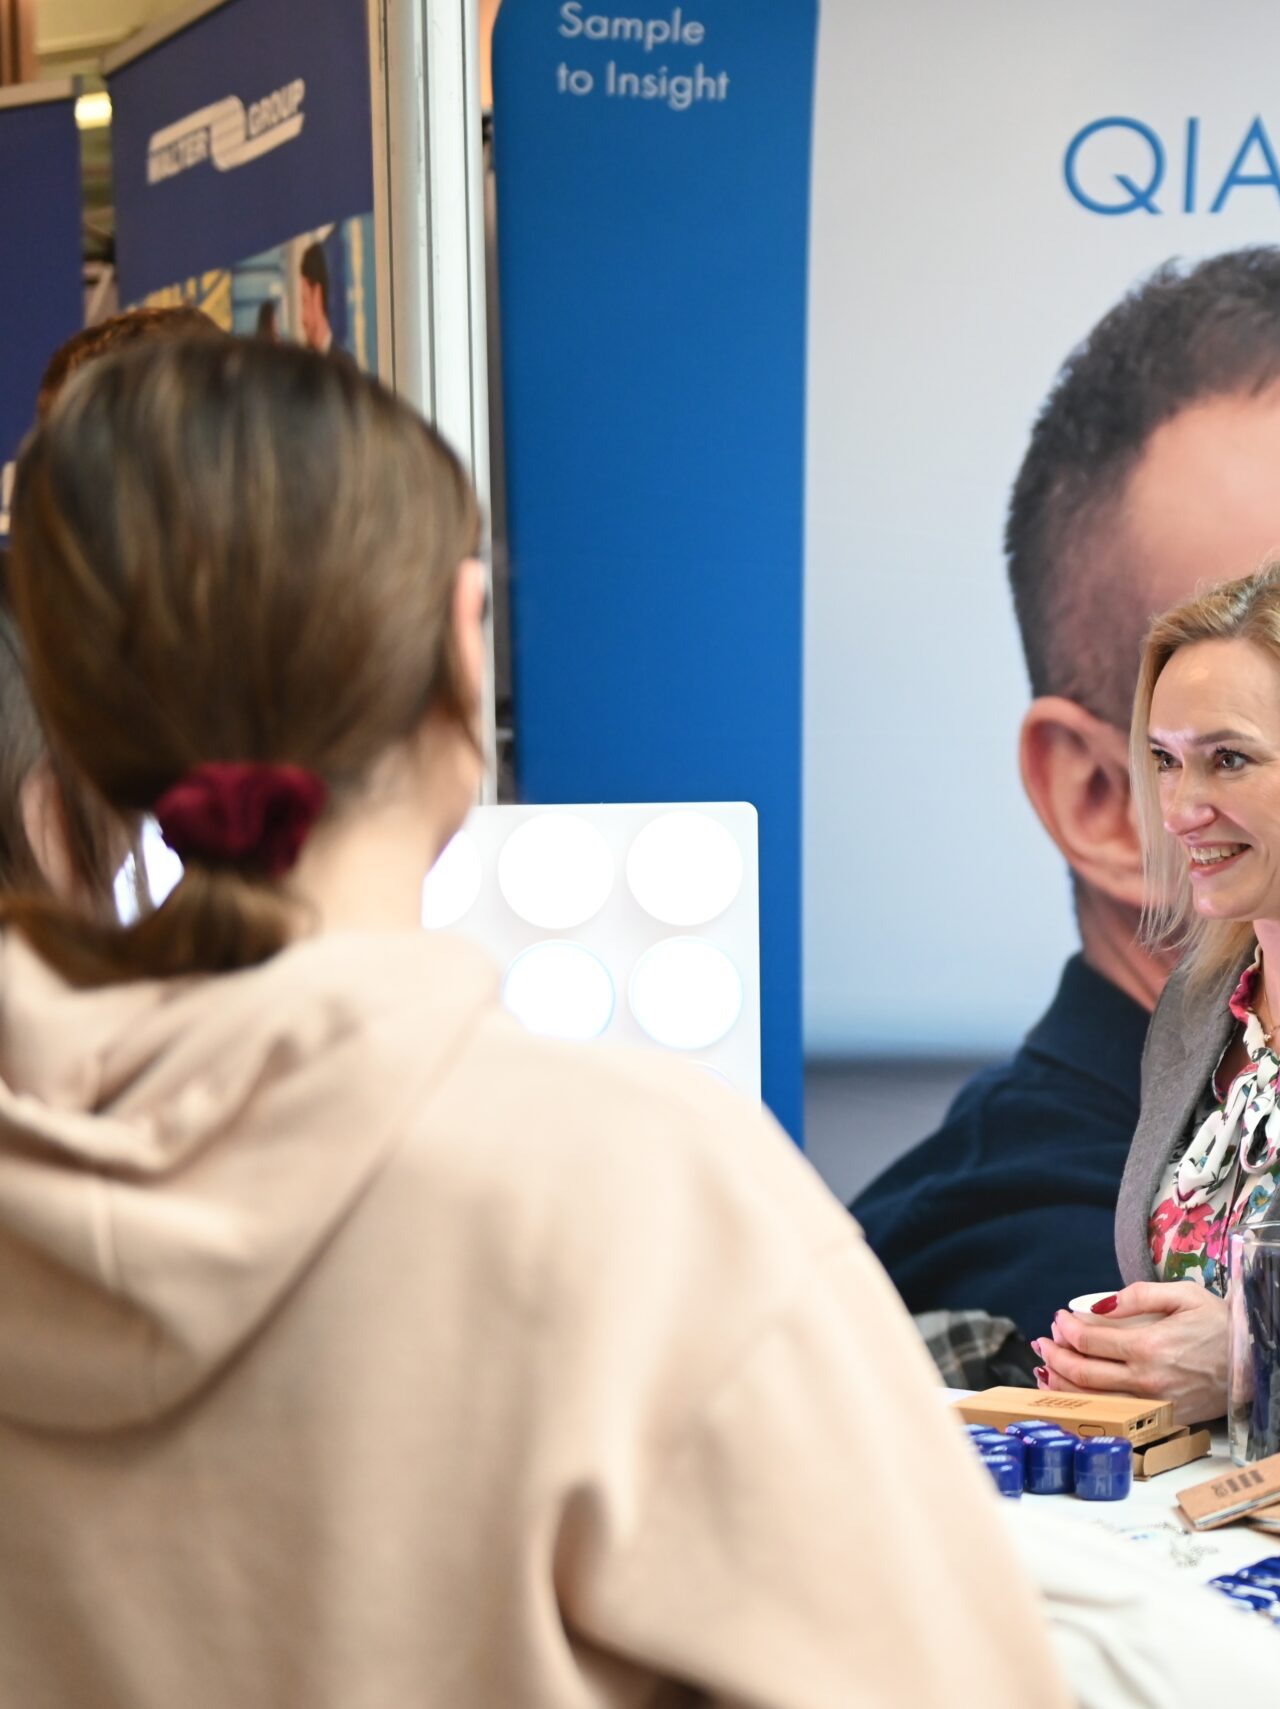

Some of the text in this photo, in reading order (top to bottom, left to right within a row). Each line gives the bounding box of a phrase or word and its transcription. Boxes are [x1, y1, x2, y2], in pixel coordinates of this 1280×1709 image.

[559, 1, 706, 52] Sample
[557, 60, 730, 111] to Insight
